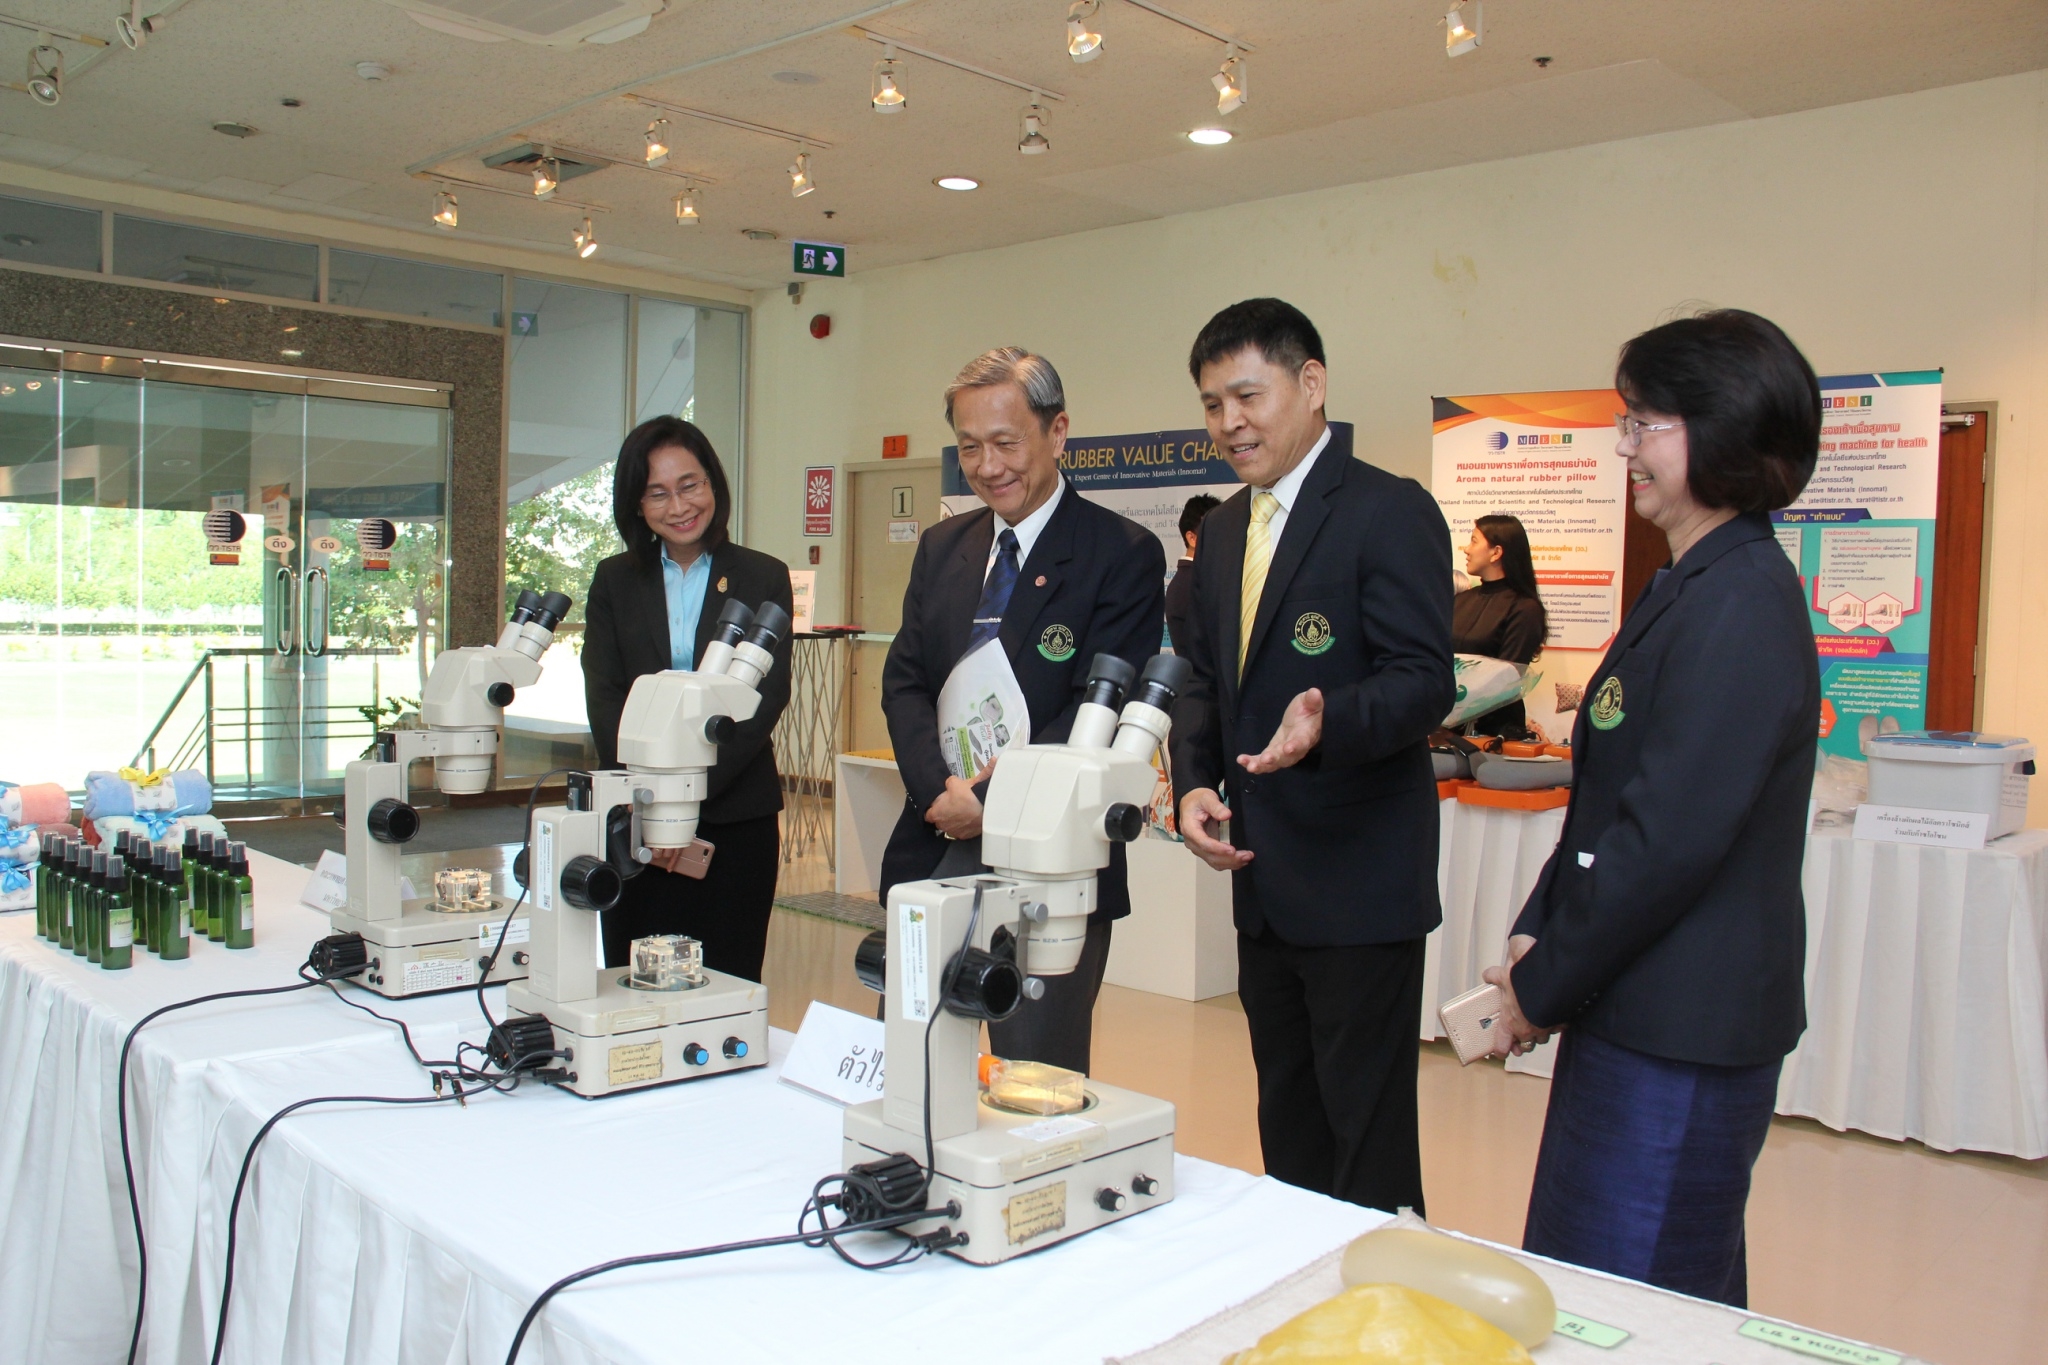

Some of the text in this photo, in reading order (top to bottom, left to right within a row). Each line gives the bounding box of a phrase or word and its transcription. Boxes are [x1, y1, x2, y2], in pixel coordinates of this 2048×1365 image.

[1822, 395, 1872, 408] HESI
[1822, 421, 1901, 436] รองเท้าเพื่อสุขภาพ
[1518, 434, 1572, 445] MHESI
[1840, 439, 1878, 450] machine
[1881, 438, 1895, 448] for
[1897, 437, 1928, 448] health
[1059, 447, 1115, 470] RUBBER
[1122, 443, 1175, 466] VALUE
[1074, 467, 1207, 482] Expert Centre of Innovative Materials (Innomat)
[1456, 473, 1597, 483] Aroma natural rubber pillow
[1858, 486, 1888, 494] (Innomat)
[898, 491, 906, 514] 1
[1542, 498, 1584, 506] Technological
[1154, 520, 1168, 529] and
[1567, 517, 1597, 525] (Innomat)
[272, 538, 287, 549] ดึง
[320, 539, 335, 550] ดึง
